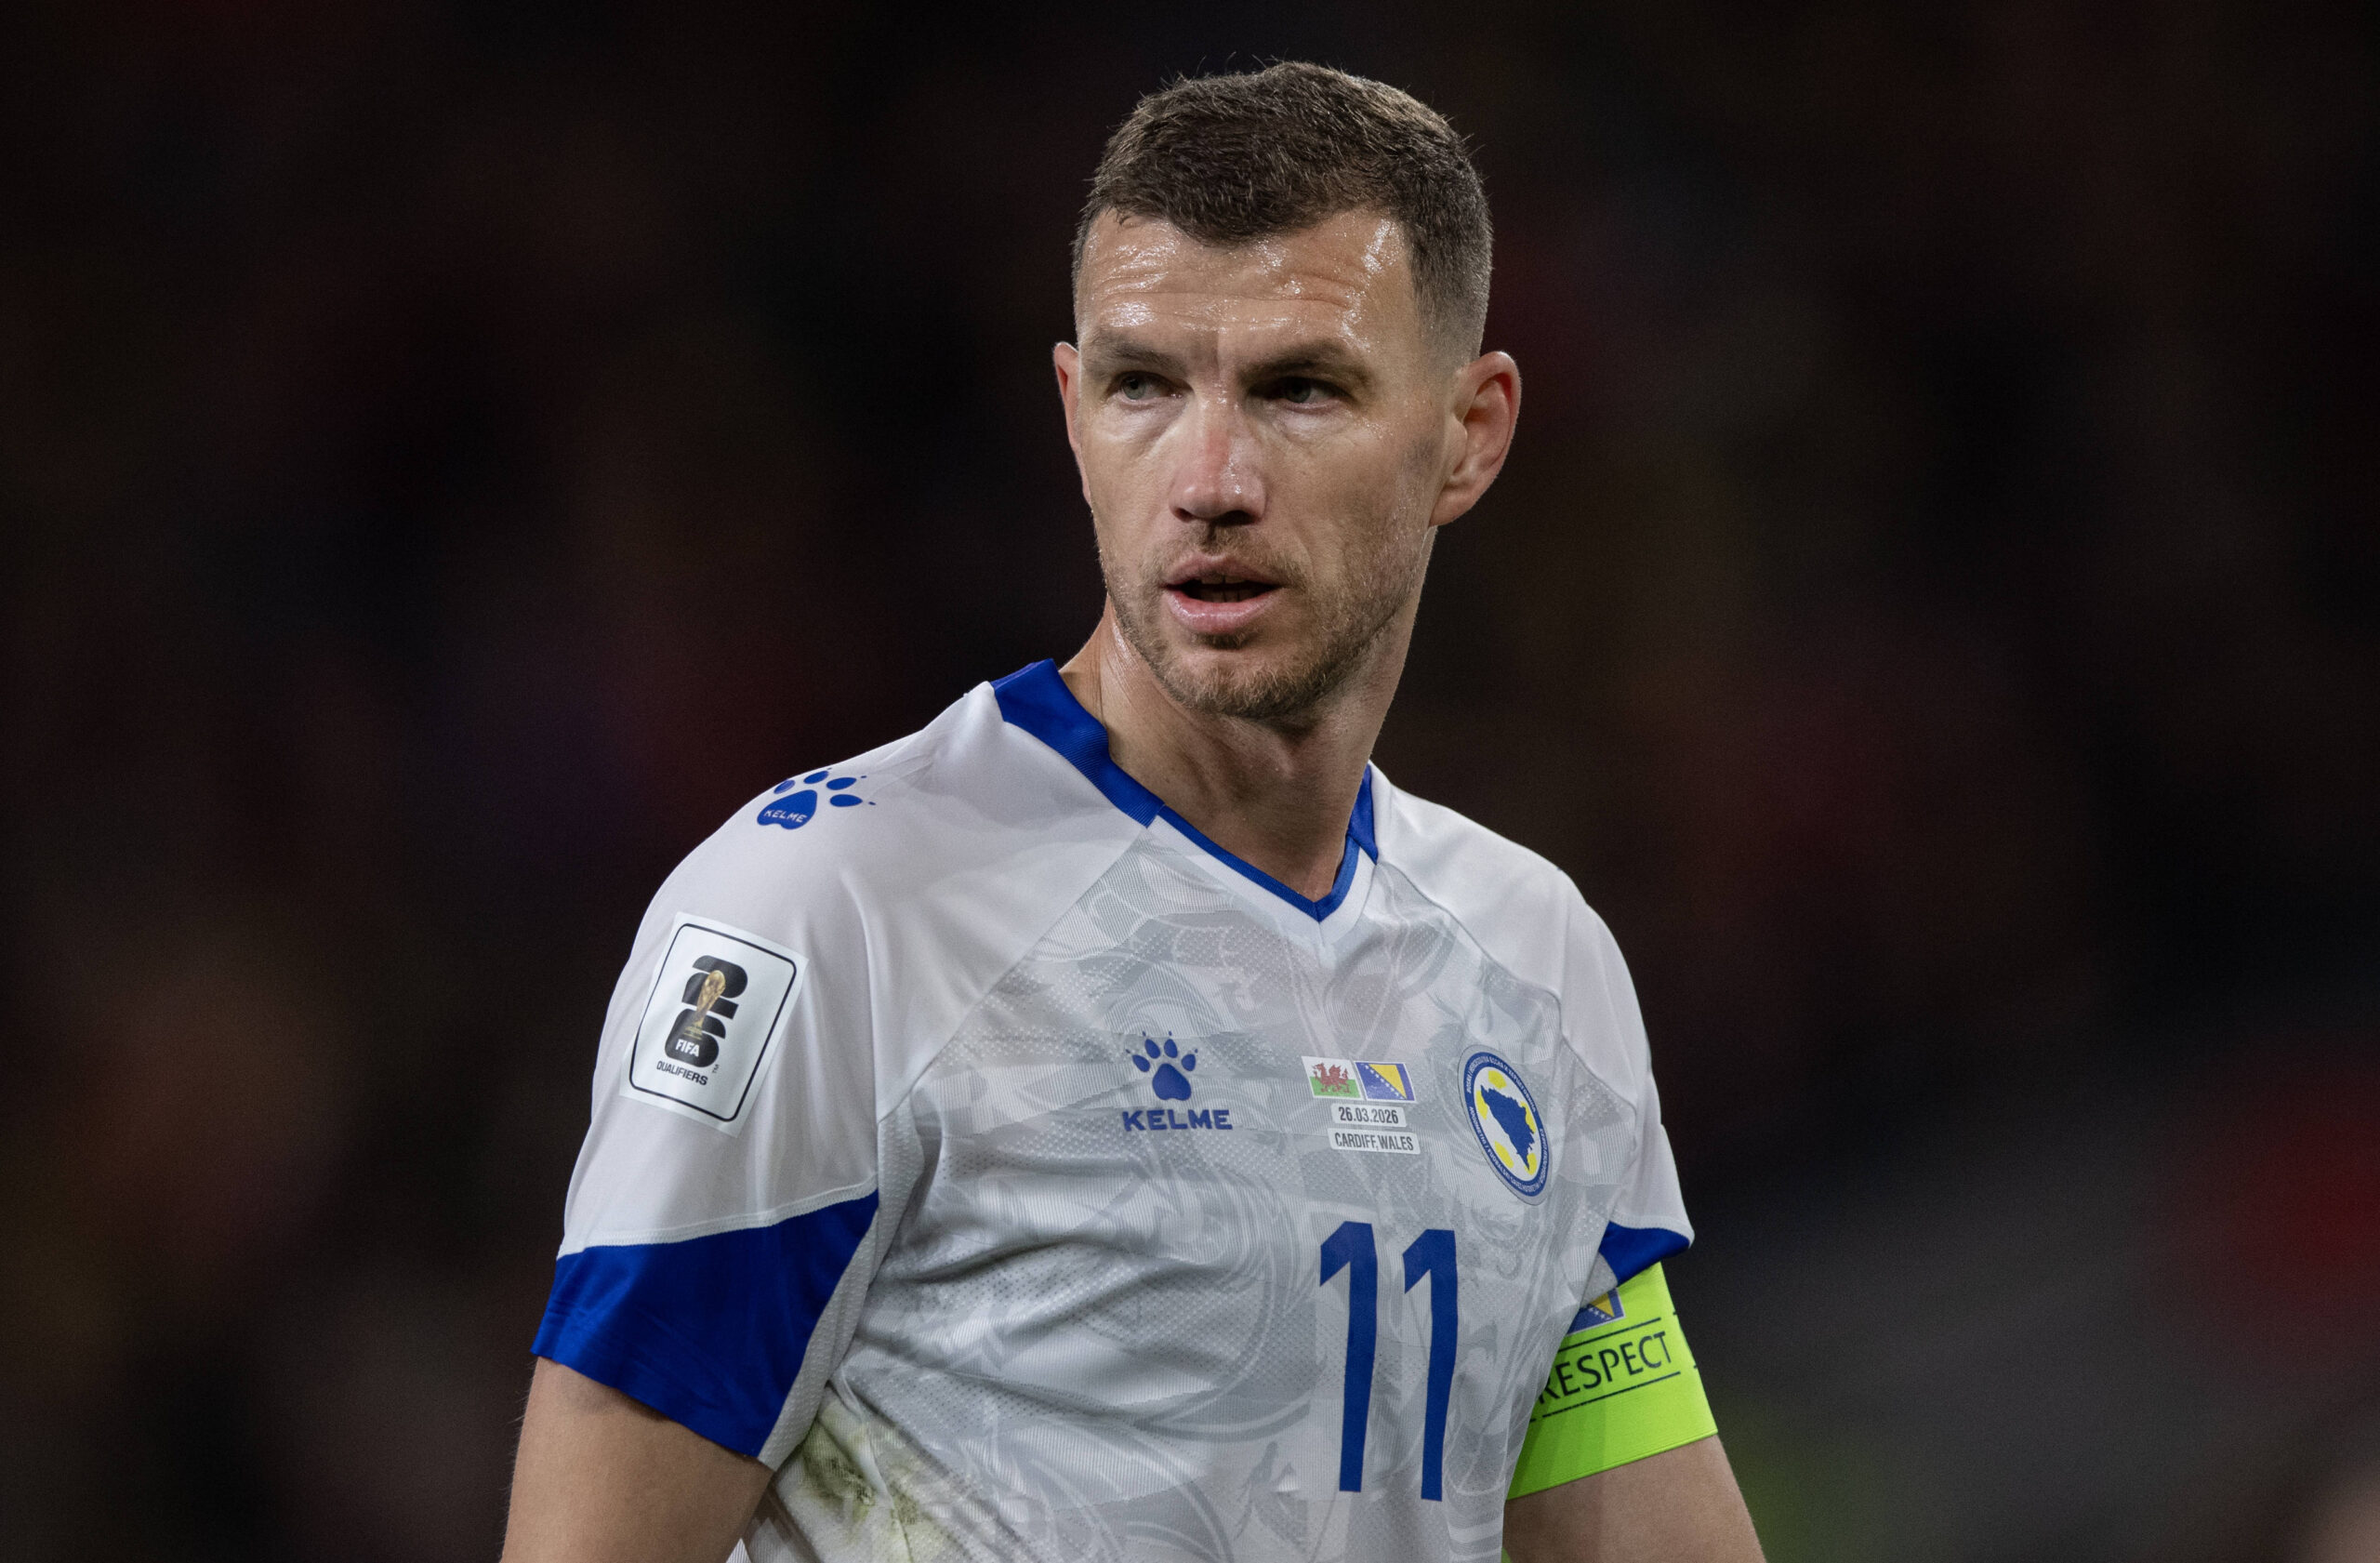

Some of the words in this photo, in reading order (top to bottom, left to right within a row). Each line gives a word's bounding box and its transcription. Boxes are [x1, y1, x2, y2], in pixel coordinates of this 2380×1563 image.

[763, 809, 807, 823] KELME
[675, 1038, 700, 1057] FIFA
[656, 1060, 708, 1086] QUALIFIERS
[1121, 1108, 1233, 1132] KELME
[1338, 1106, 1399, 1124] 26.03.2026
[1377, 1134, 1414, 1151] WALES
[1319, 1220, 1459, 1503] 11
